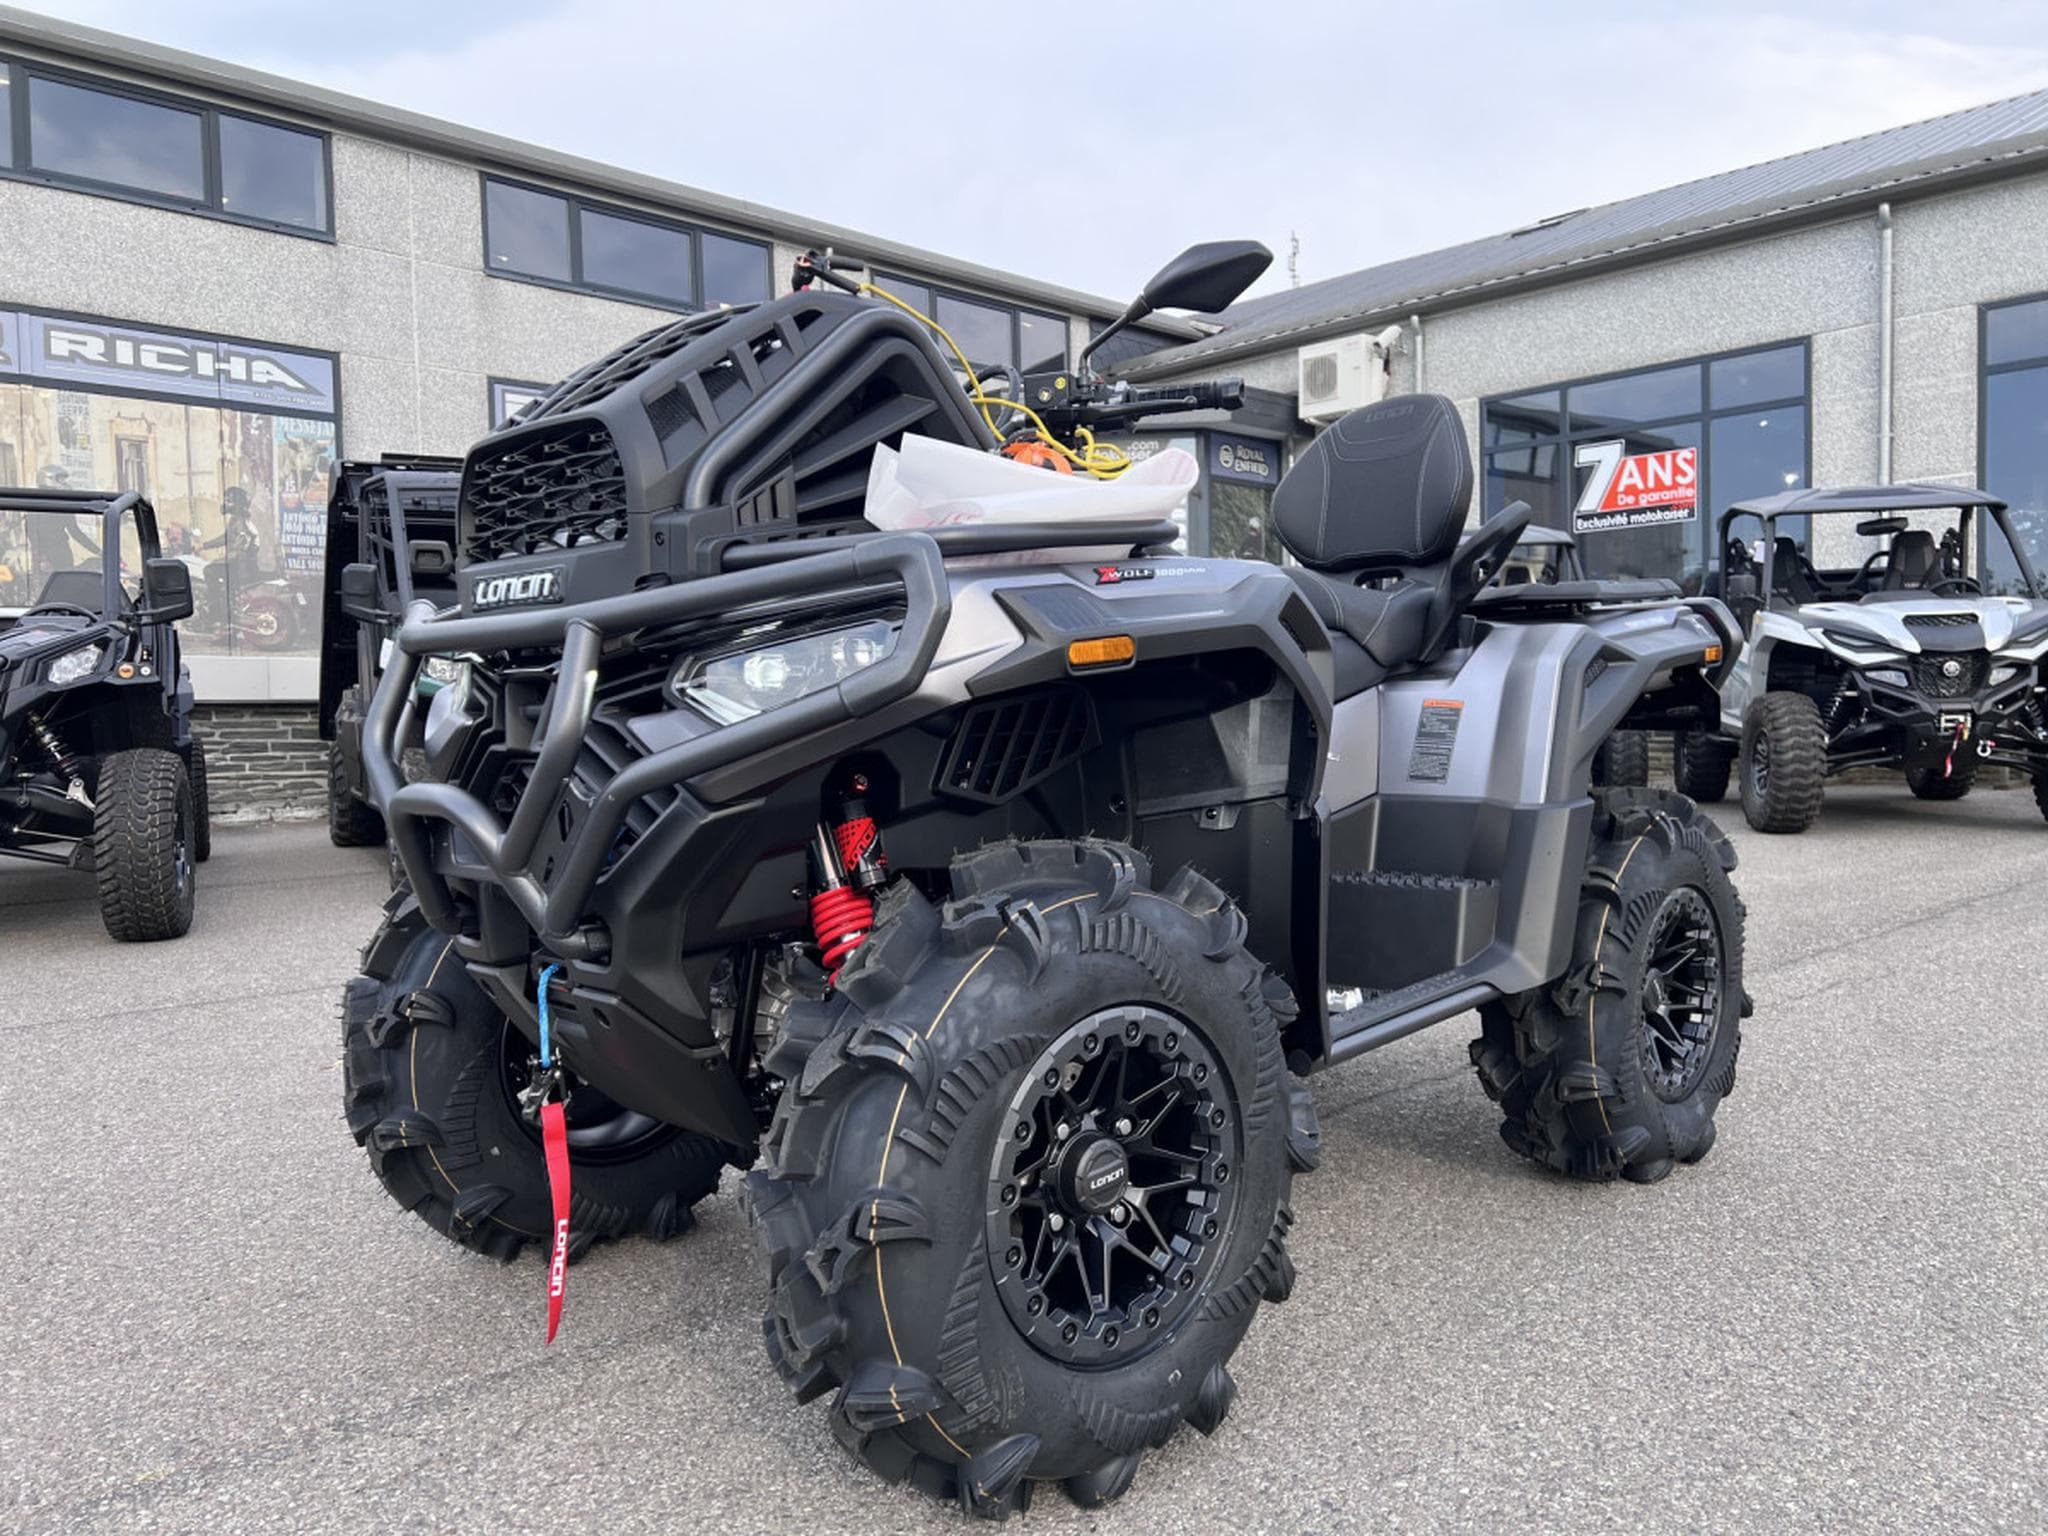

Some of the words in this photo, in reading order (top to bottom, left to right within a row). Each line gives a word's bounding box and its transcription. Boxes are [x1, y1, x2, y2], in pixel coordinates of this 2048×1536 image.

[50, 330, 307, 389] RICHA
[1237, 445, 1264, 461] ROYAL
[1235, 459, 1269, 476] ENFIELD
[1576, 441, 1623, 512] 7
[1617, 451, 1694, 492] ANS
[1617, 493, 1635, 505] De
[1639, 486, 1694, 506] garantie
[1577, 513, 1628, 529] Exclusivité
[476, 573, 553, 604] LONCIN
[1090, 1167, 1124, 1190] LONCIN
[551, 1219, 569, 1296] LONCIN
